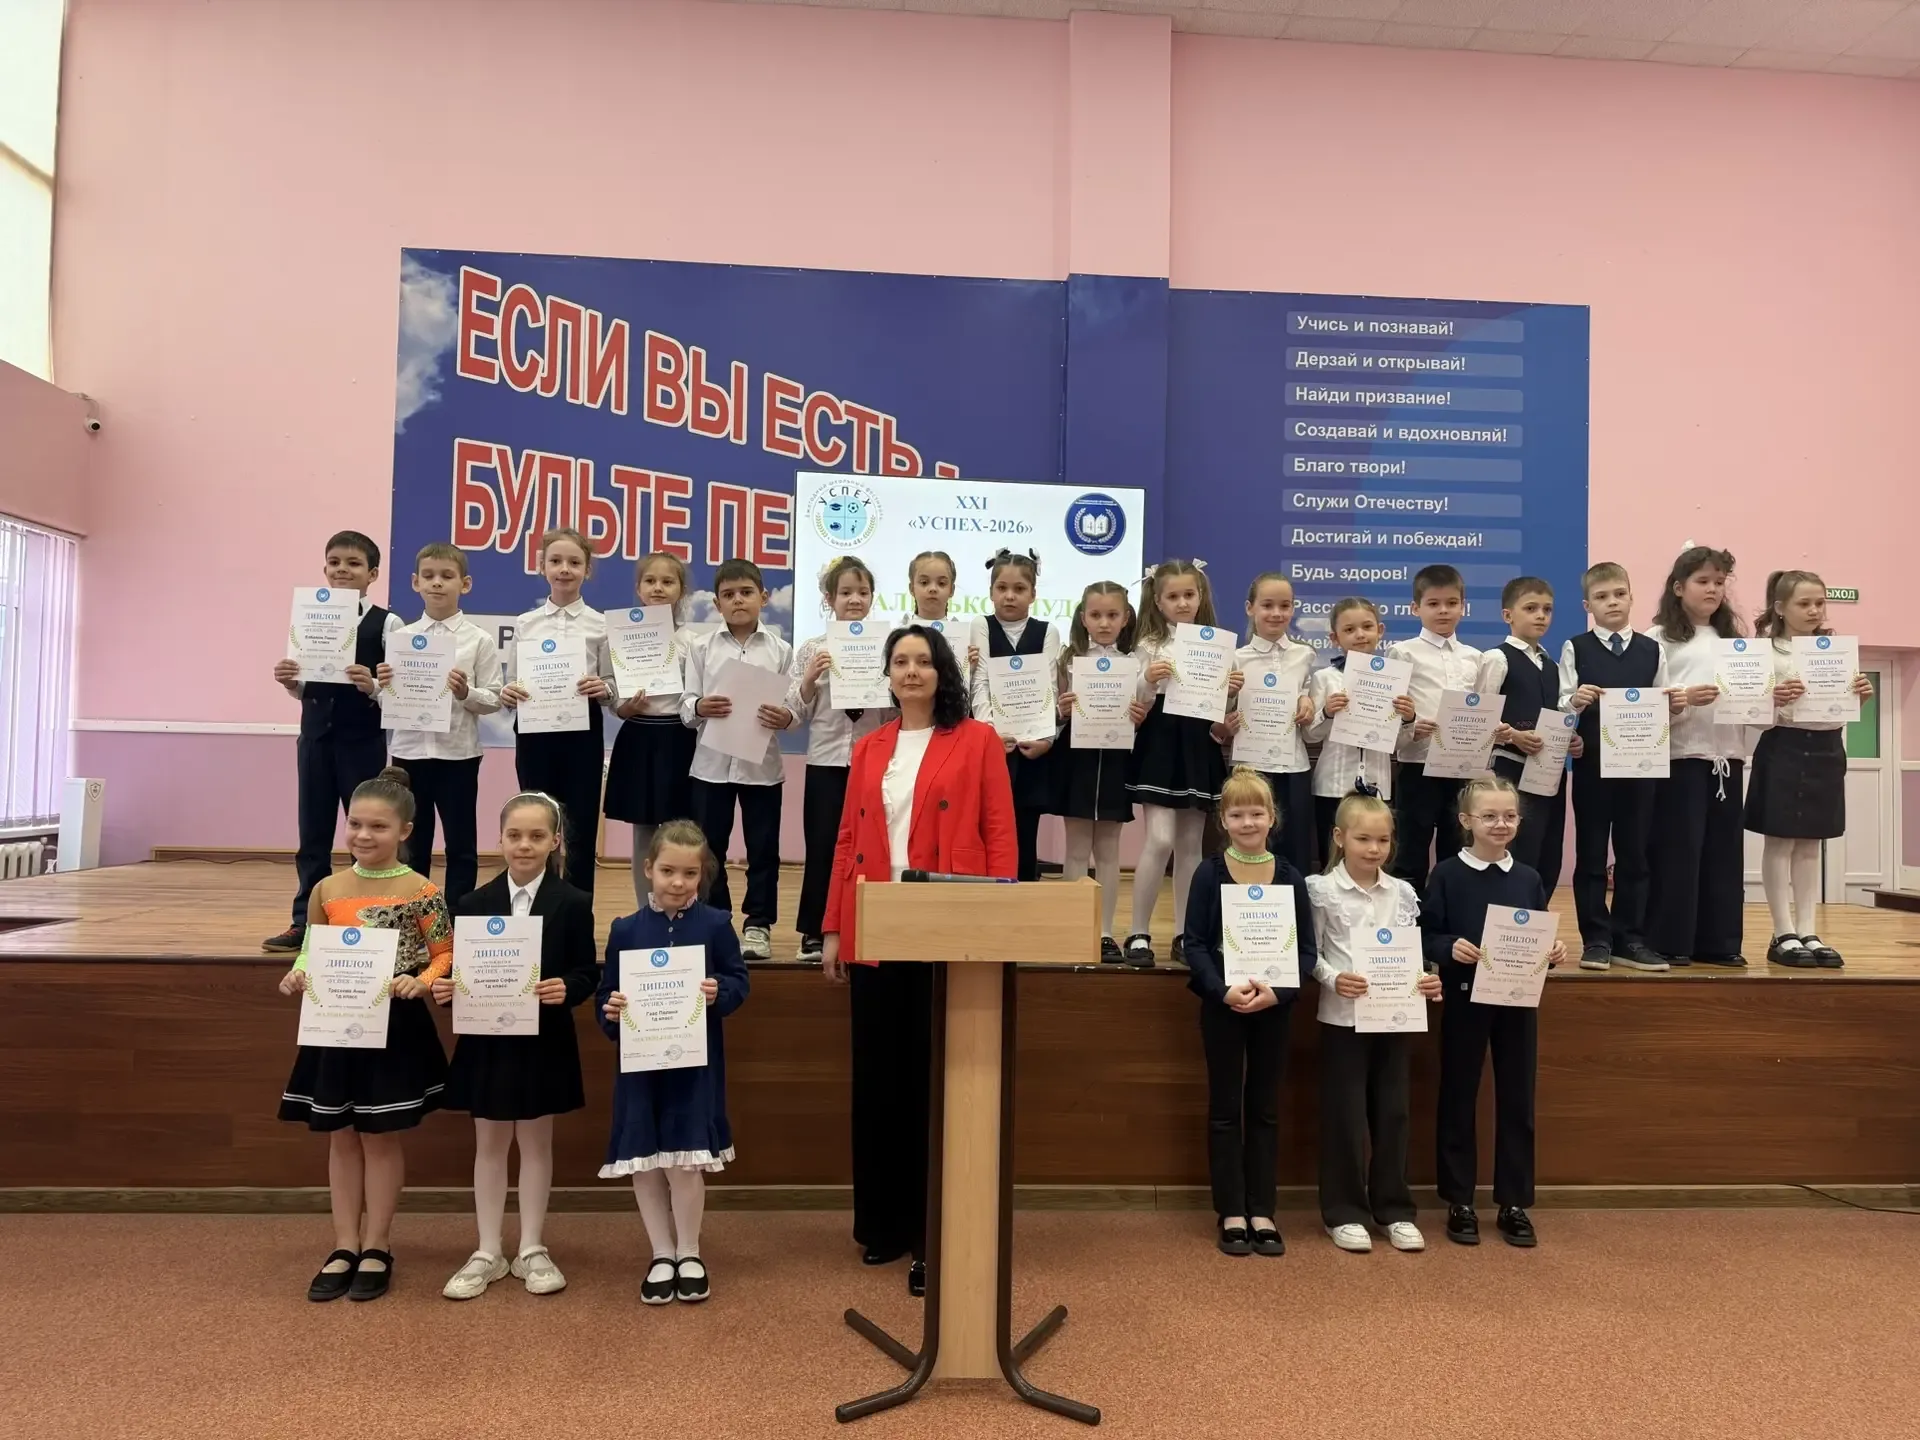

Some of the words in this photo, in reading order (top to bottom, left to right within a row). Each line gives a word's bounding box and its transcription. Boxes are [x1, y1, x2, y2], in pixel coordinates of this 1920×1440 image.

[1297, 316, 1349, 332] Учись
[1354, 320, 1364, 331] и
[1370, 320, 1454, 335] познавай!
[1296, 351, 1357, 368] Дерзай
[1363, 356, 1373, 367] и
[1378, 356, 1466, 371] открывай!
[456, 265, 630, 416] ЕСЛИ
[643, 330, 748, 445] ВЫ
[763, 372, 923, 477] ЕСТЬ
[1296, 387, 1350, 403] Найди
[1355, 391, 1451, 406] призвание!
[1295, 422, 1377, 439] Создавай
[1383, 428, 1393, 438] и
[1399, 428, 1507, 443] вдохновляй!
[1294, 458, 1345, 473] Благо
[1350, 460, 1406, 476] твори!
[818, 486, 872, 507] УСПЕХ
[956, 495, 989, 511] XXI
[1293, 493, 1349, 510] Служи
[1354, 495, 1449, 513] Отечеству!
[451, 437, 693, 575] БУДЬТЕ
[706, 481, 794, 570] ПЕ
[908, 515, 1033, 534] «УСПЕХ-2026»
[1291, 529, 1372, 545] Достигай
[1377, 533, 1387, 544] и
[1392, 532, 1483, 548] побеждай!
[1291, 564, 1334, 580] Будь
[1340, 566, 1408, 581] здоров!
[1826, 589, 1856, 599] ЫХОД
[1239, 911, 1278, 920] ДИПЛОМ
[1499, 934, 1538, 945] ДИПЛОМ
[472, 948, 520, 959] ДИПЛОМ
[1368, 956, 1406, 965] ДИПЛОМ
[325, 959, 374, 969] ДИПЛОМ
[638, 980, 685, 992] ДИПЛОМ
